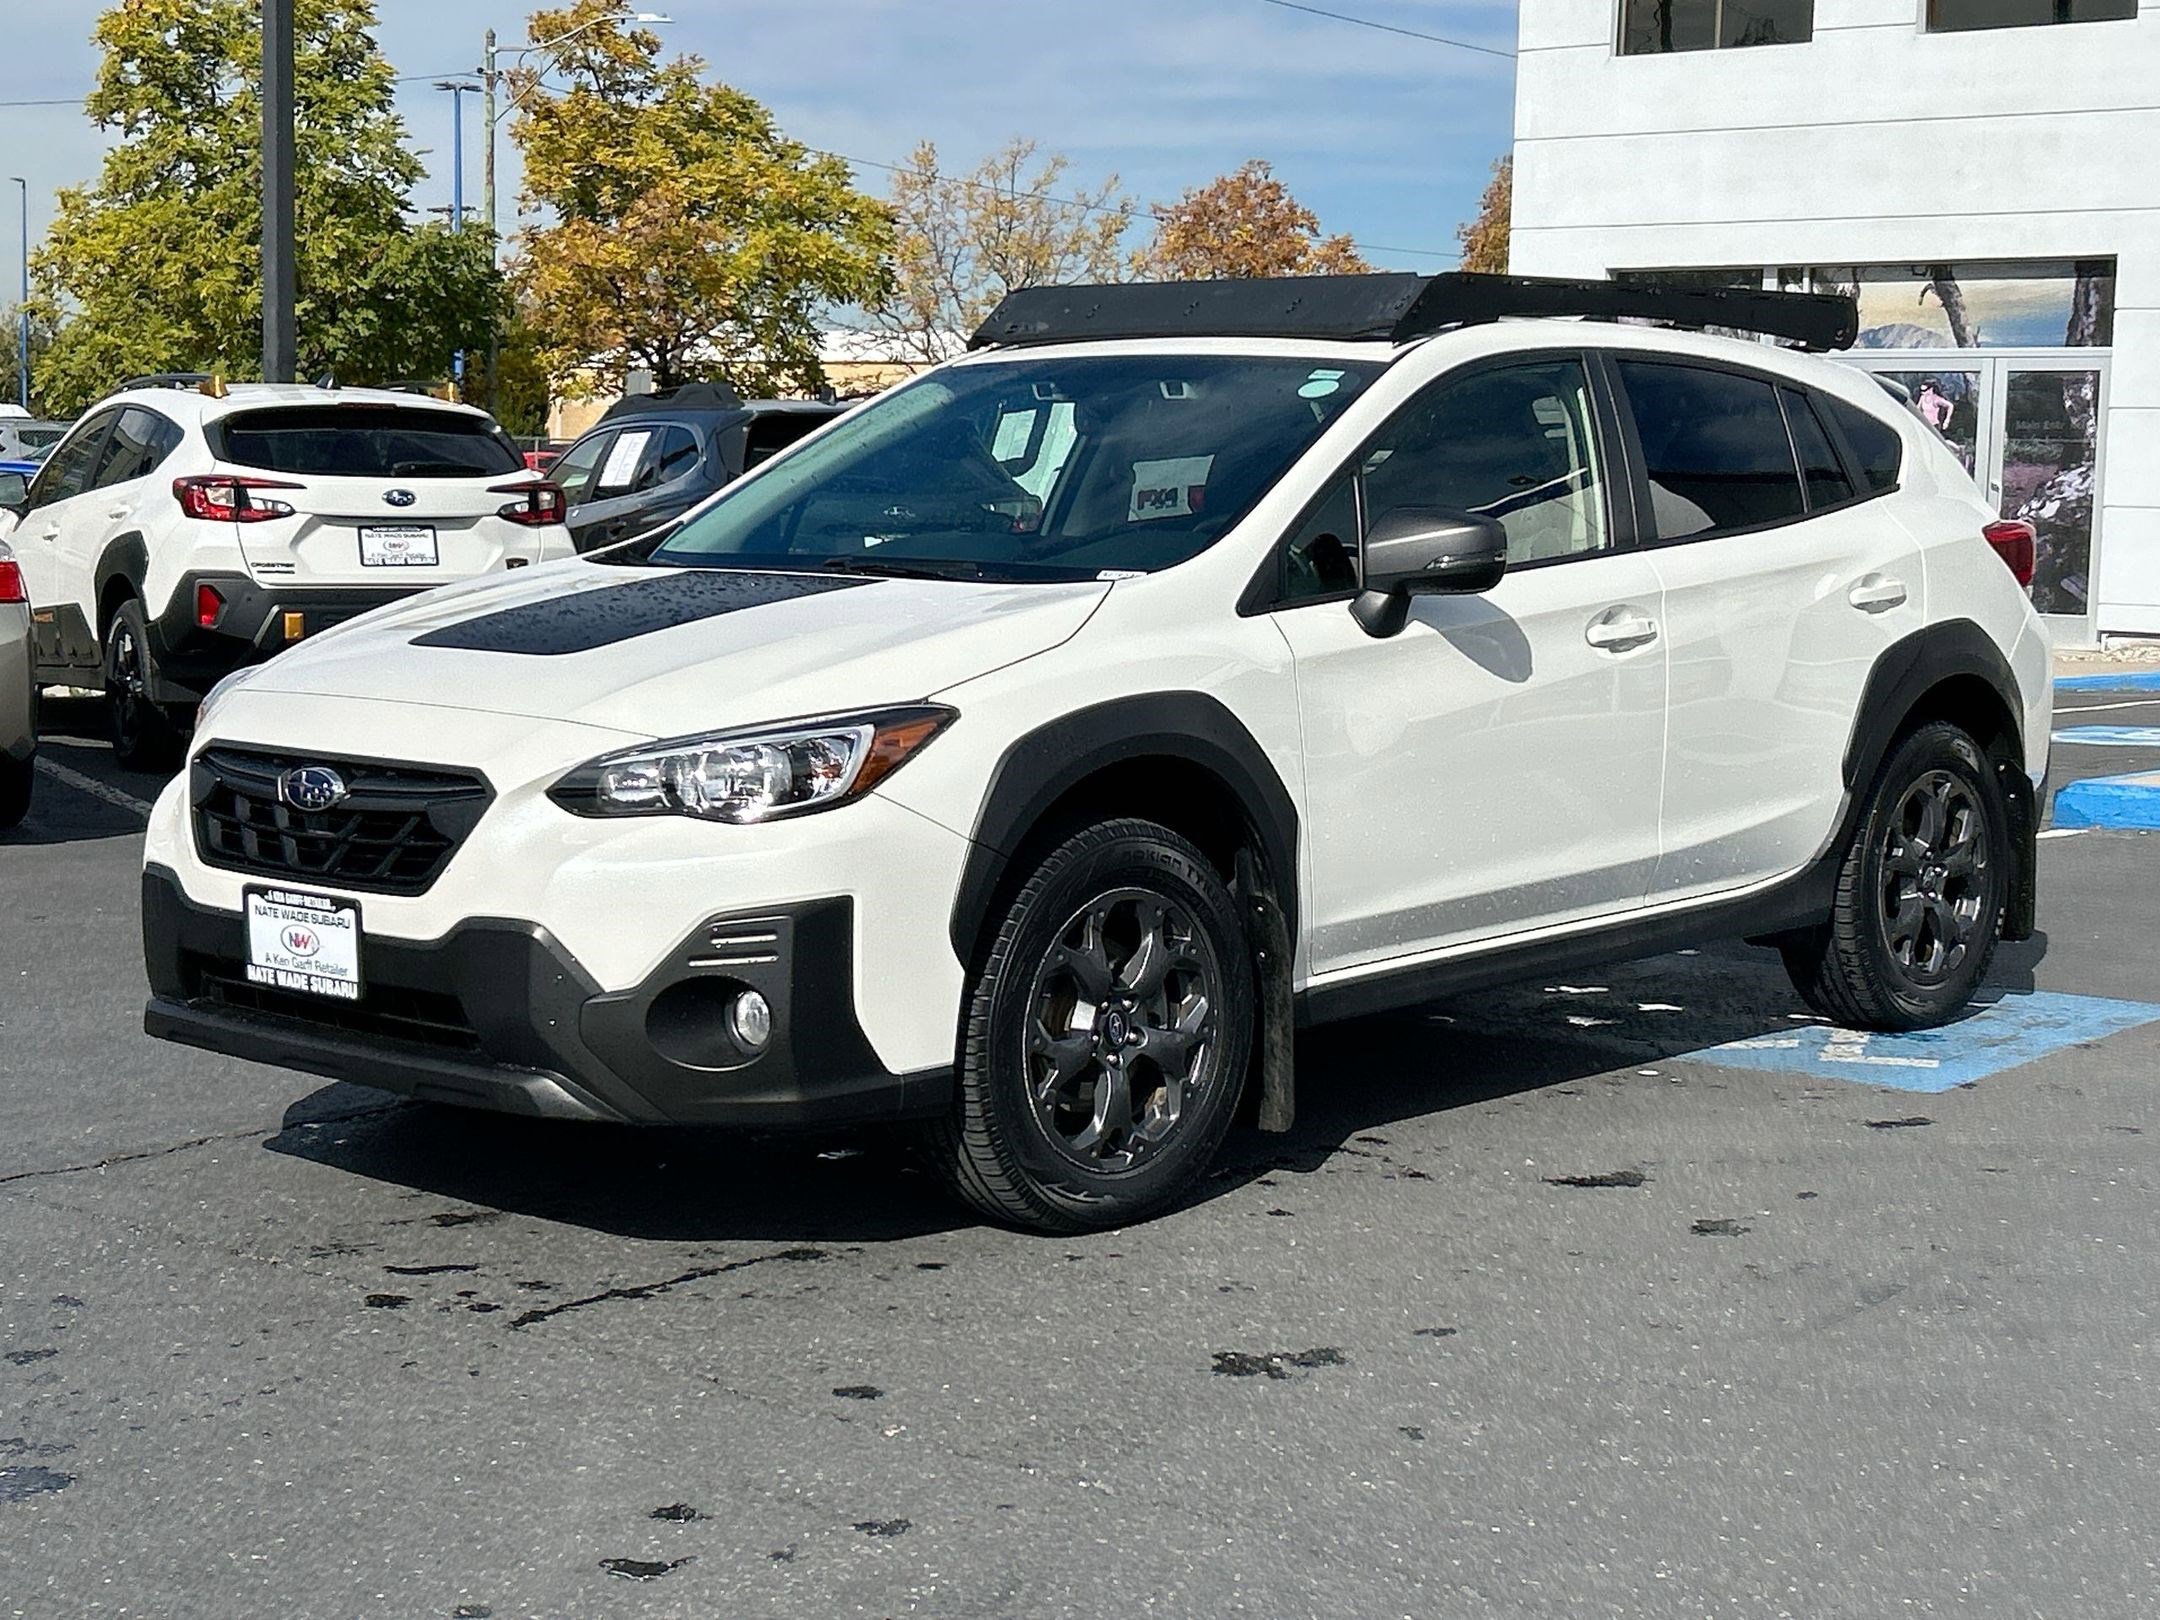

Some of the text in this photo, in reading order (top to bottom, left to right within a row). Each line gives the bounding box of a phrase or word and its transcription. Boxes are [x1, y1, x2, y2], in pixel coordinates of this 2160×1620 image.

[255, 905, 351, 929] NATE WADE SUBARU
[265, 952, 272, 963] A
[273, 953, 290, 966] Ken
[315, 960, 348, 976] Retailer
[247, 964, 358, 1000] NATE WADE SUBARU
